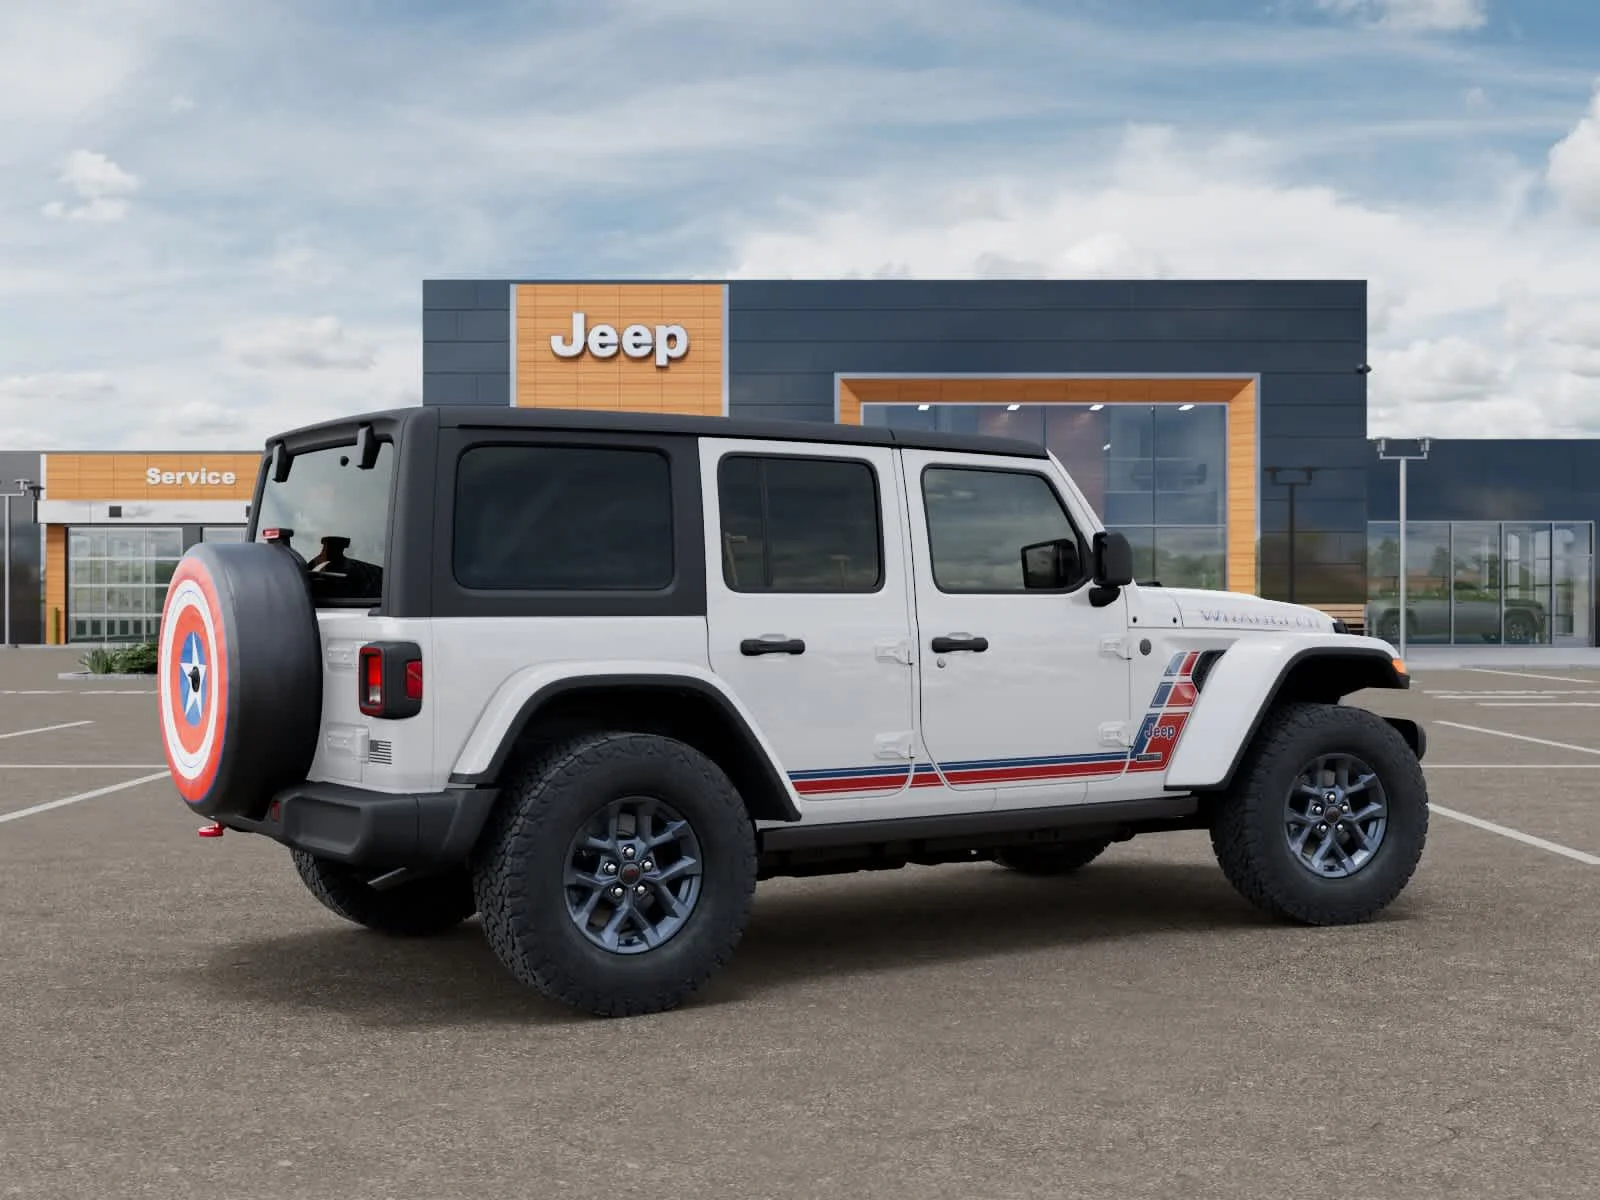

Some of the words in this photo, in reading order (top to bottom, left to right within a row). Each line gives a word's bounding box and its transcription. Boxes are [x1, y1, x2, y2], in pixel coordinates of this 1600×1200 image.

[550, 312, 689, 367] Jeep
[146, 467, 236, 485] Service
[1144, 723, 1175, 740] Jeep
